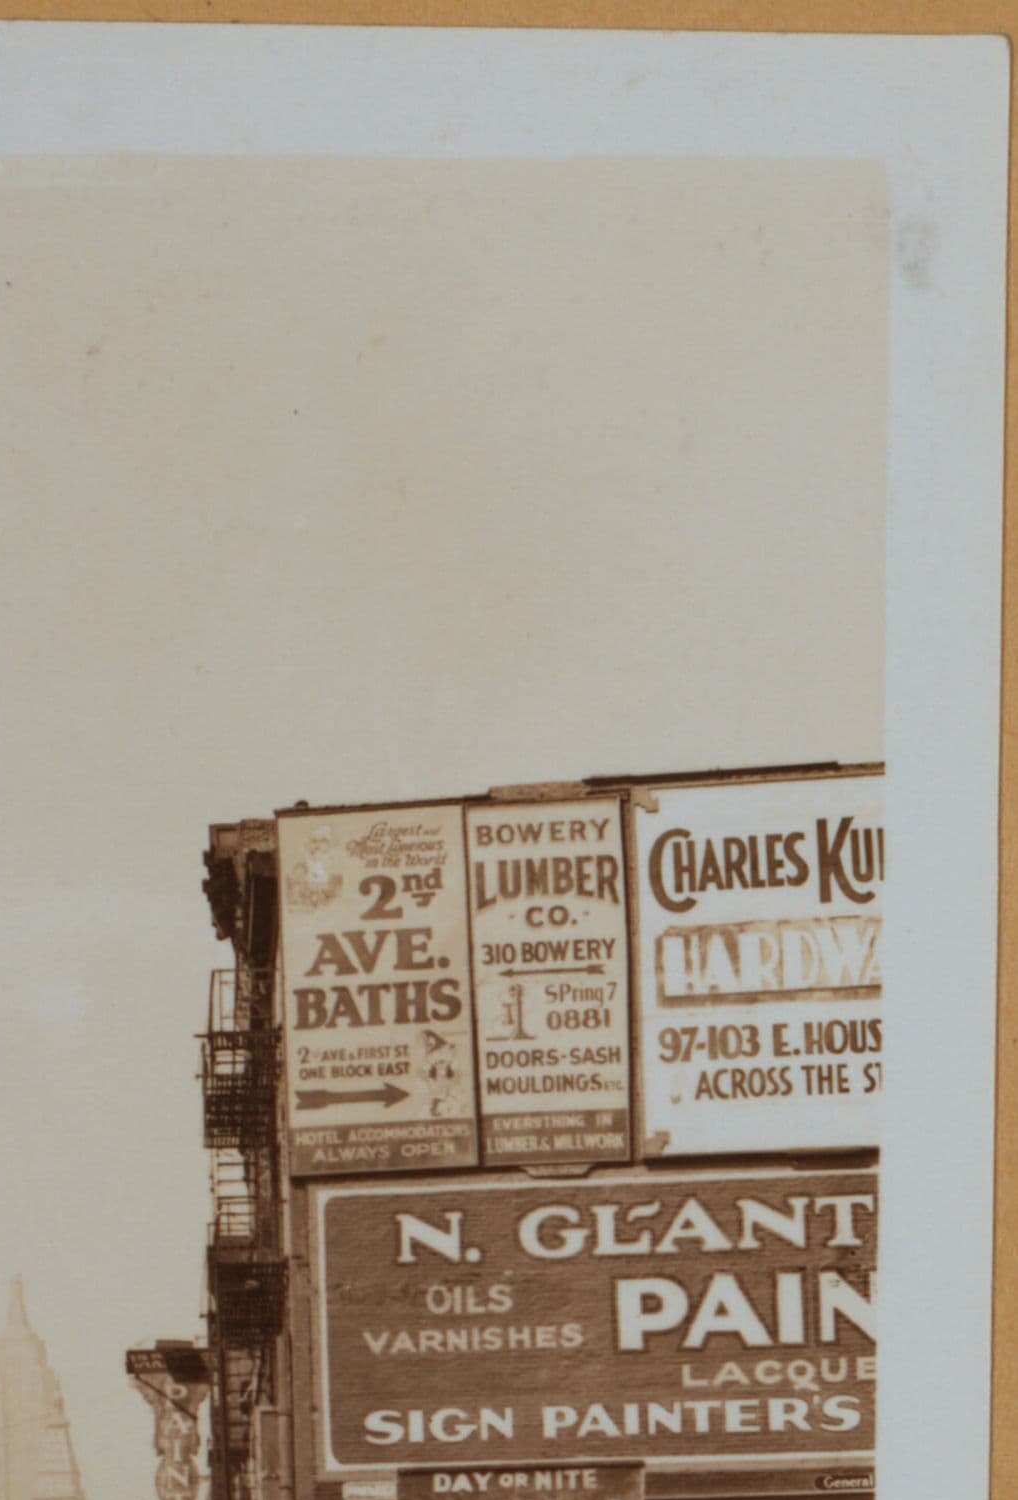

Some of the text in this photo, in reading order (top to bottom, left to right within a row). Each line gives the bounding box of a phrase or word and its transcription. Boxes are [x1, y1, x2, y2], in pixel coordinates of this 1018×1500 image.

[476, 817, 610, 846] BOWERY
[648, 816, 884, 913] CHARLES KU
[359, 867, 443, 920] 2nd
[474, 855, 620, 911] LUMBER
[304, 928, 451, 977] AVE.
[482, 938, 615, 965] 310 BOWERY
[293, 978, 462, 1031] BATHS
[606, 981, 618, 1001] 7
[546, 1008, 611, 1031] 0881
[320, 1048, 347, 1062] AVE
[357, 1046, 391, 1060] FIRST
[658, 1023, 760, 1063] 97-103
[298, 1062, 411, 1081] ONE BLOCK EAST
[487, 1073, 602, 1095] MOULDINGS
[694, 1066, 793, 1100] ACROSS
[800, 1063, 850, 1095] THE
[295, 1124, 471, 1146] HOTEL ACCOMMODATIONS
[492, 1112, 613, 1131] EVERYTHING IN
[312, 1141, 456, 1163] ALWAYS OPEN
[485, 1136, 538, 1155] LUMBER
[553, 1132, 625, 1151] MILLWORK
[395, 1211, 481, 1263] N.
[426, 1284, 514, 1314] OILS
[362, 1323, 584, 1354] VARNISHES
[683, 1356, 877, 1391] LACQUE
[364, 1395, 861, 1444] SIGN PAINTER'S
[433, 1472, 493, 1493] DAY
[534, 1469, 598, 1490] NITE
[823, 1474, 874, 1489] General
